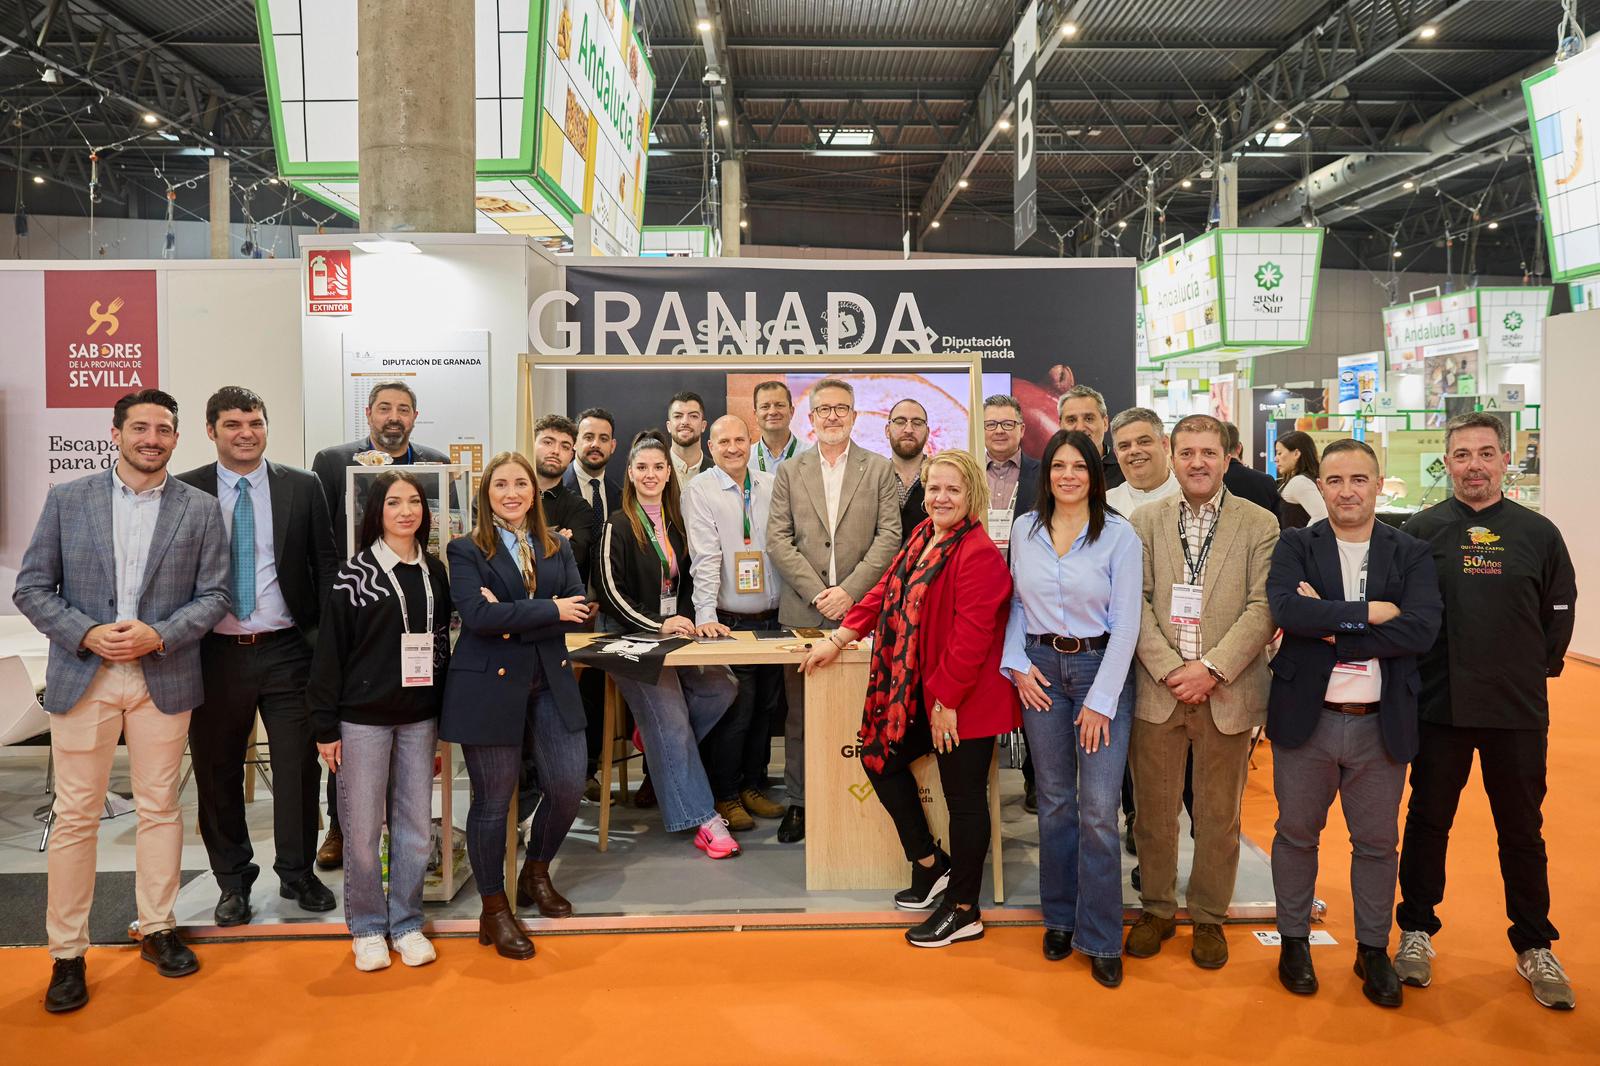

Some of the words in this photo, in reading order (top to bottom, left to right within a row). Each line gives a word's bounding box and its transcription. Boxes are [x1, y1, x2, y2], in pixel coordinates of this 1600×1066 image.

[578, 12, 634, 152] Andalucía
[1018, 79, 1033, 181] B
[1253, 294, 1284, 304] gusto
[1262, 302, 1283, 314] Sur
[528, 290, 929, 356] GRANADA
[1404, 317, 1456, 343] Andalucía
[942, 335, 1011, 349] Diputación
[69, 343, 142, 359] SABORES
[382, 358, 430, 366] DIPUTACIÓN
[432, 358, 442, 366] DE
[443, 358, 482, 366] GRANADA
[69, 370, 143, 388] SEVILLA
[48, 435, 120, 455] Escapa
[48, 457, 96, 474] para
[1463, 567, 1502, 575] especiales
